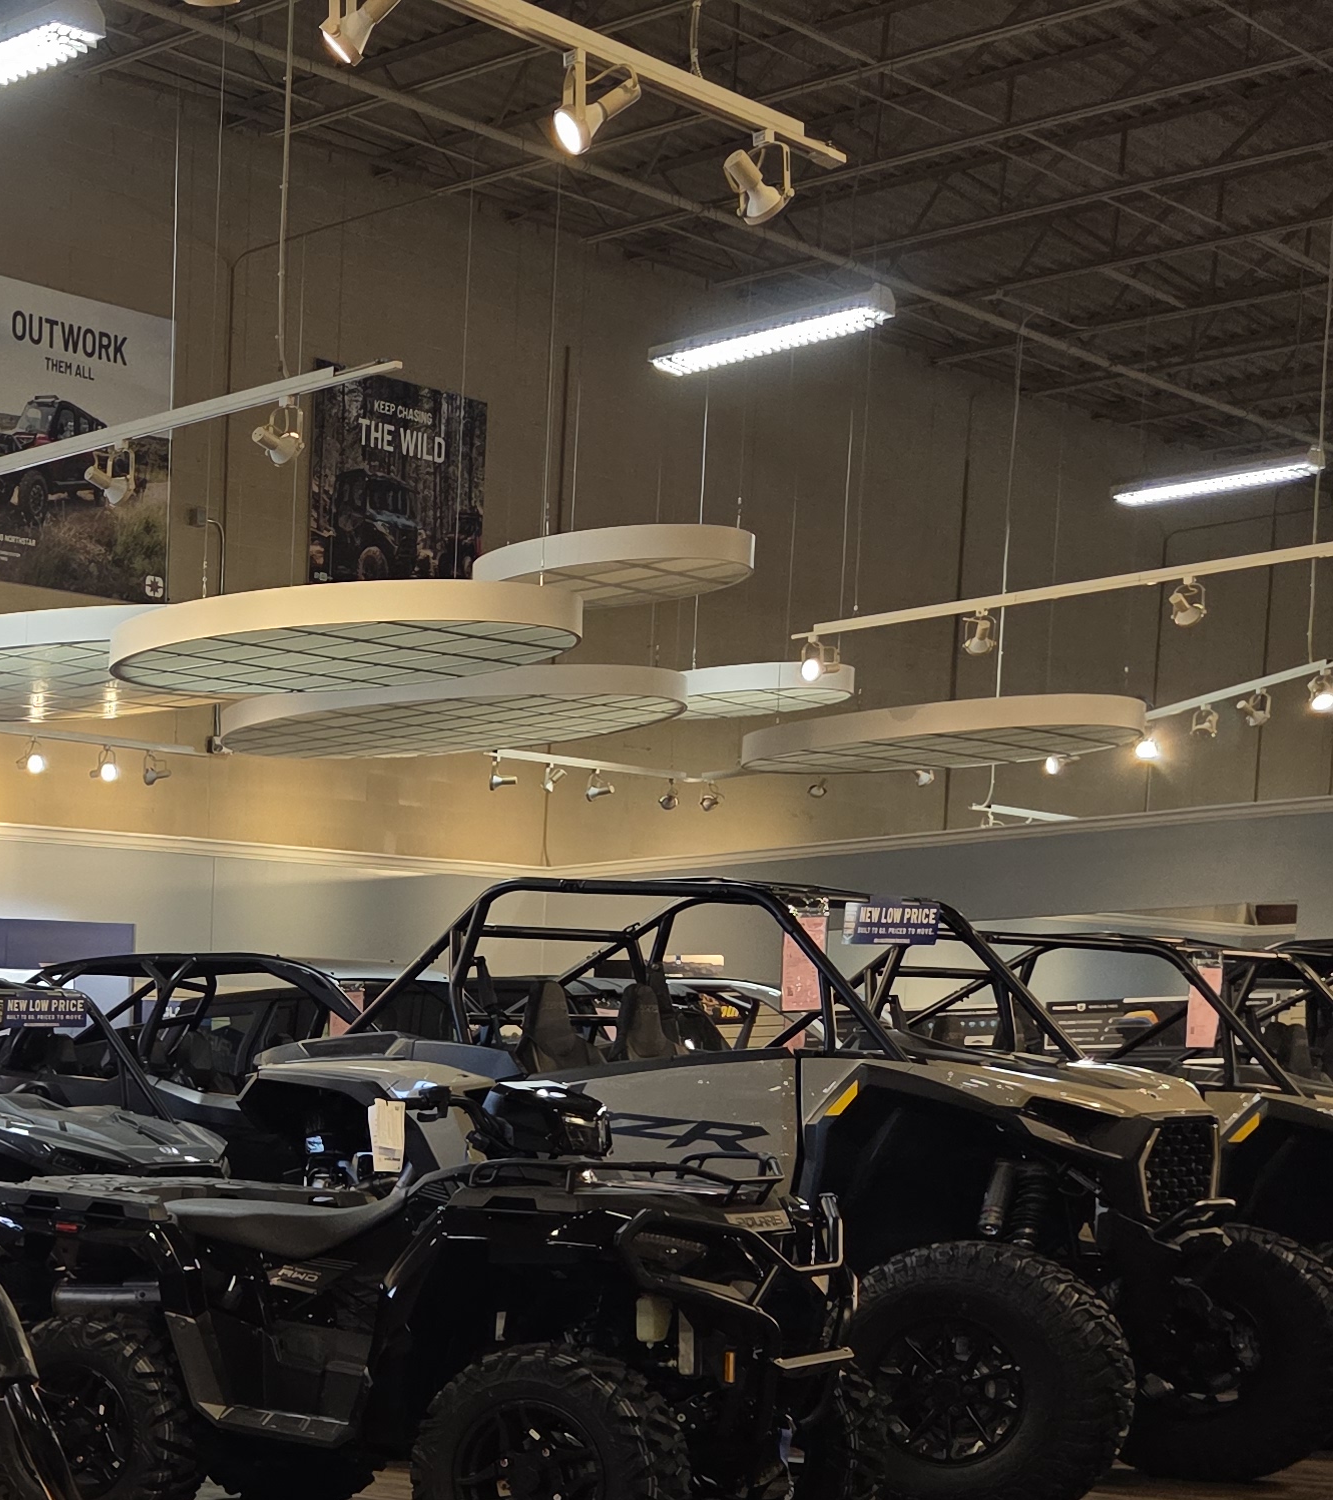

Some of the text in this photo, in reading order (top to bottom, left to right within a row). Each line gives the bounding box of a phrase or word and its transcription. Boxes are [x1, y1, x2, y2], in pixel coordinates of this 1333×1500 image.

[12, 310, 128, 366] OUTWORK
[45, 356, 95, 381] THEM ALL
[373, 400, 433, 425] KEEP CHASING
[358, 417, 446, 463] THE WILD
[859, 906, 881, 923] NEW
[880, 907, 903, 924] LOW
[903, 908, 938, 924] PRICE
[6, 999, 28, 1012] NEW
[28, 999, 49, 1012] LOW
[51, 1000, 85, 1012] PRICE
[608, 1110, 771, 1153] ZR
